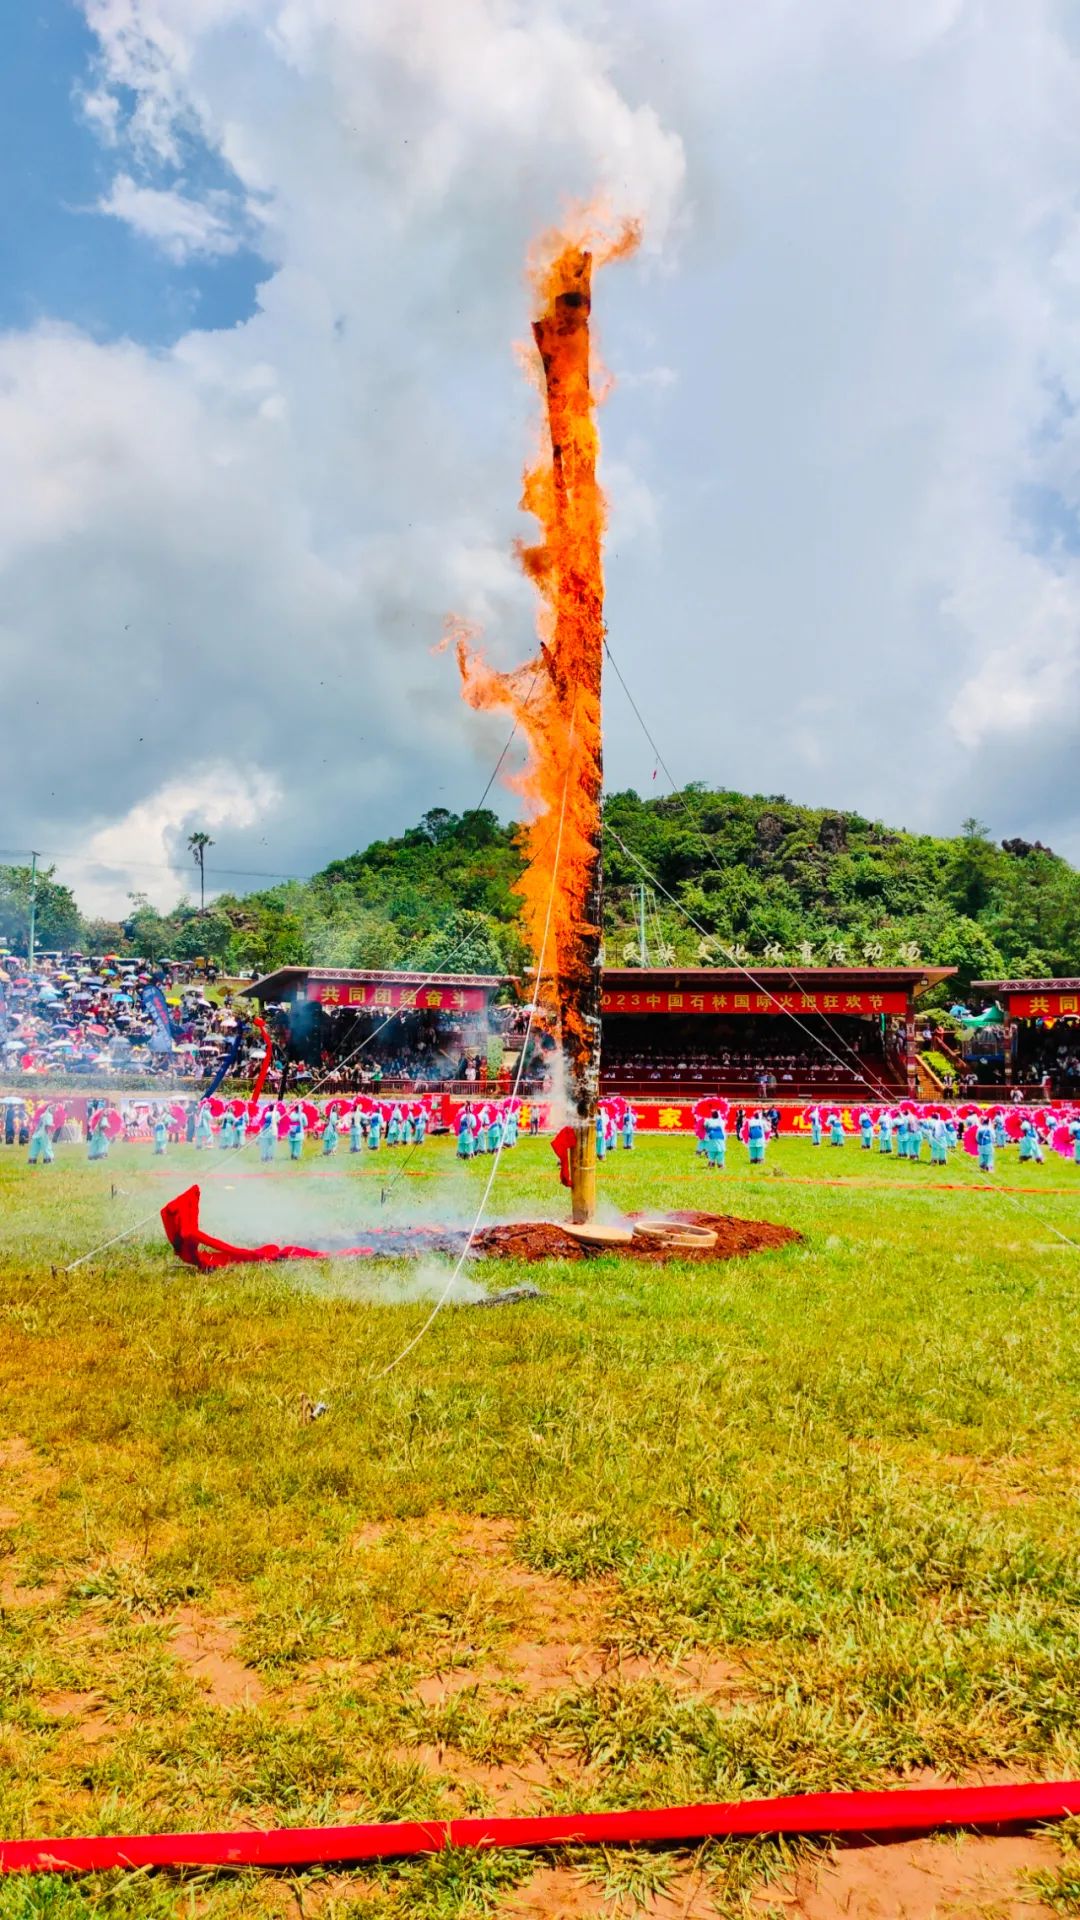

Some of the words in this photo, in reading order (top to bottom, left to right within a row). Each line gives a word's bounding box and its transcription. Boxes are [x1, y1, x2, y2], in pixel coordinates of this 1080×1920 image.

[320, 985, 467, 1007] 共同团结奋斗
[1029, 996, 1079, 1014] 共同
